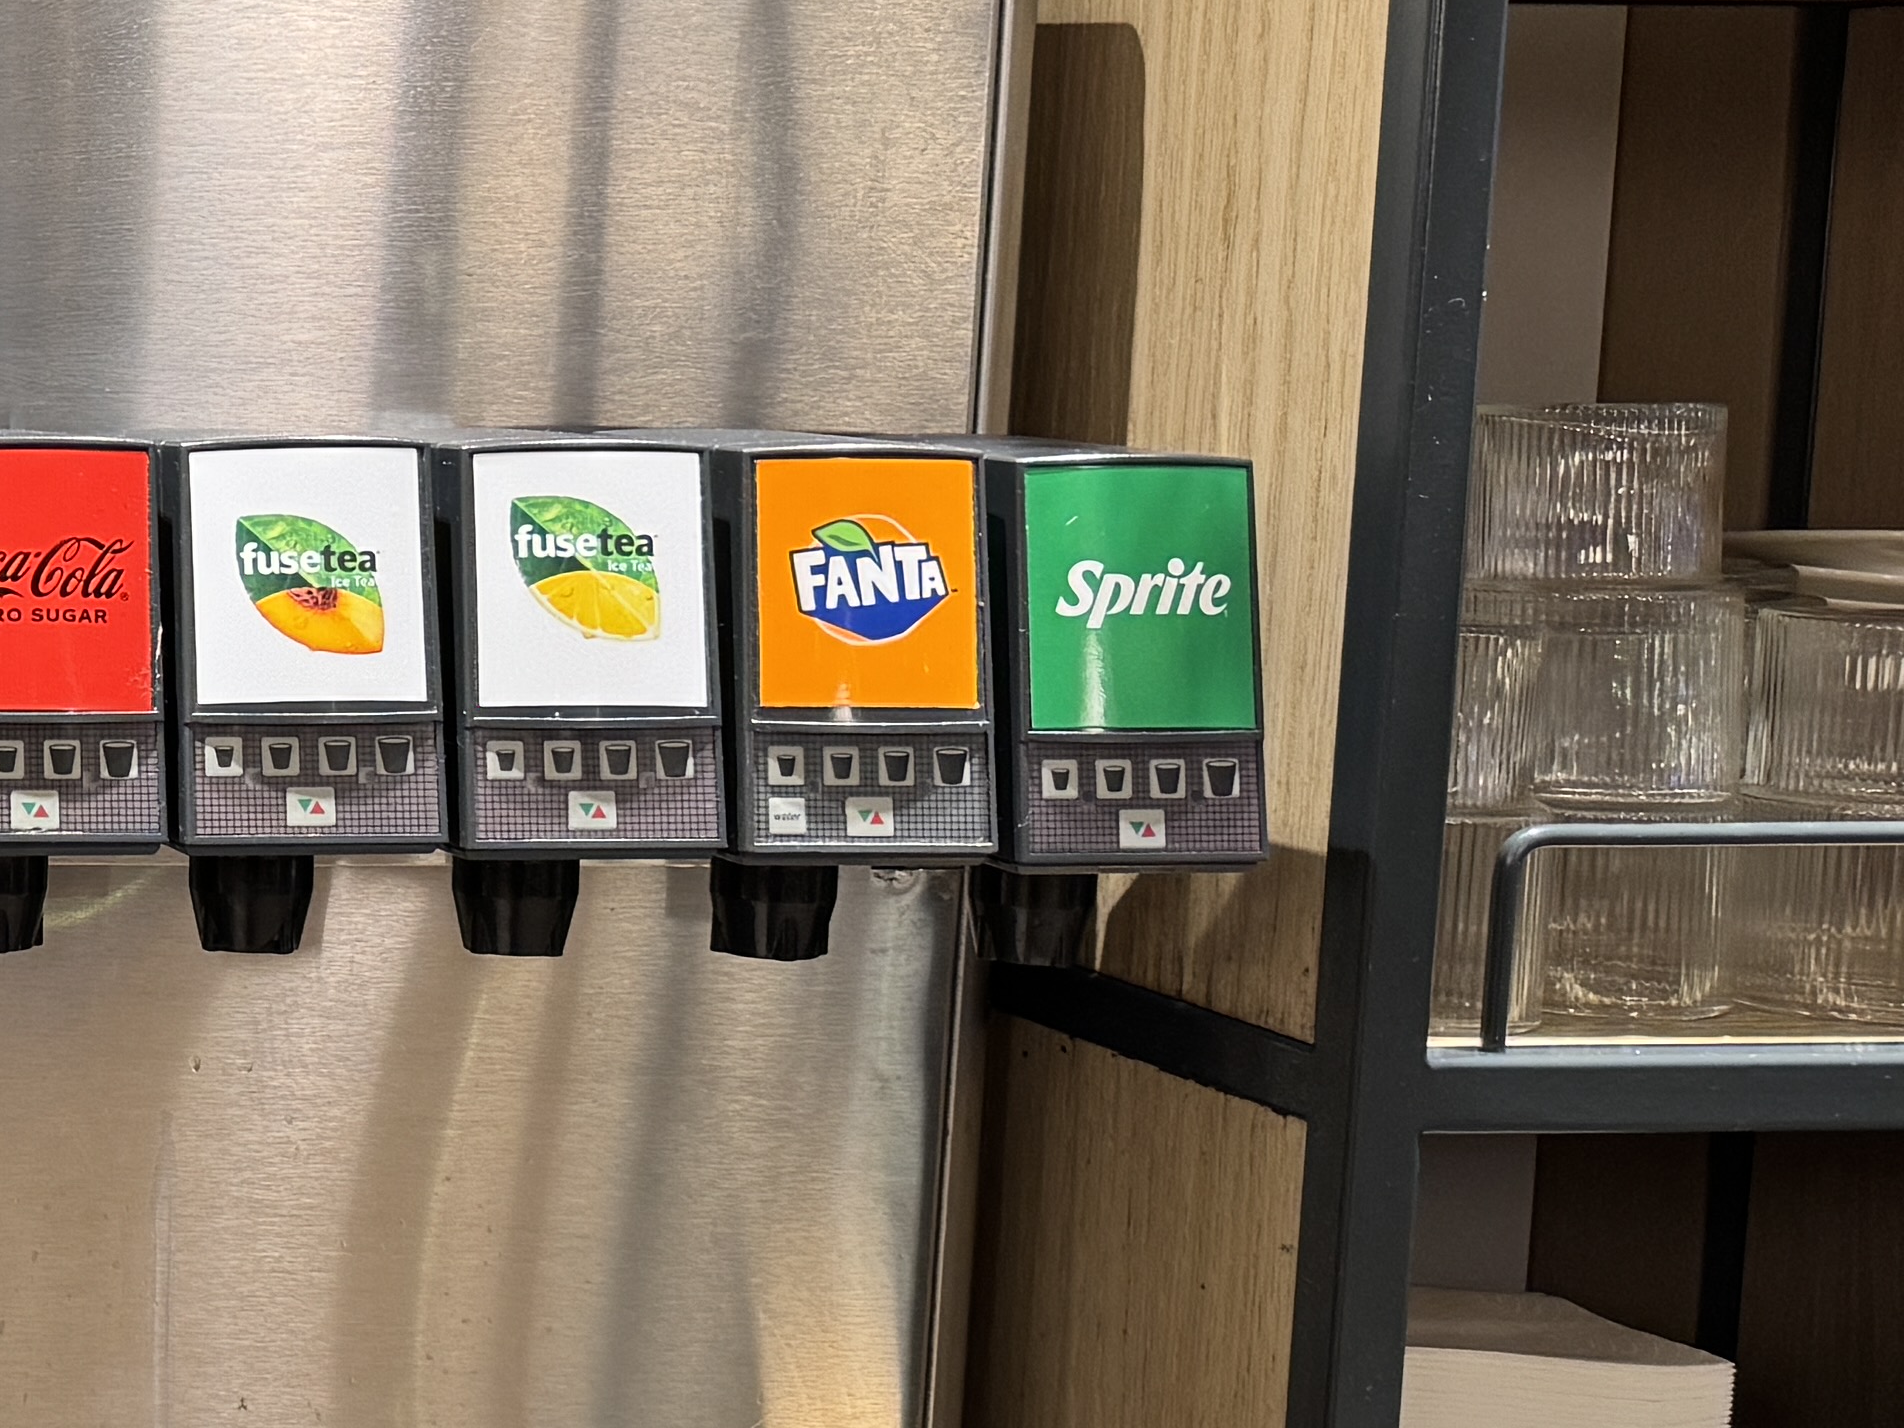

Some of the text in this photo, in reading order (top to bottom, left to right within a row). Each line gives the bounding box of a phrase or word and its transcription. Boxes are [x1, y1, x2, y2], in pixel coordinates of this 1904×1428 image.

[514, 524, 656, 560] fusetea
[238, 542, 378, 577] fusetea
[606, 559, 655, 572] Ice Tea
[330, 576, 377, 588] Ice Tea
[1055, 558, 1232, 629] Sprite
[30, 607, 108, 624] SUGAR
